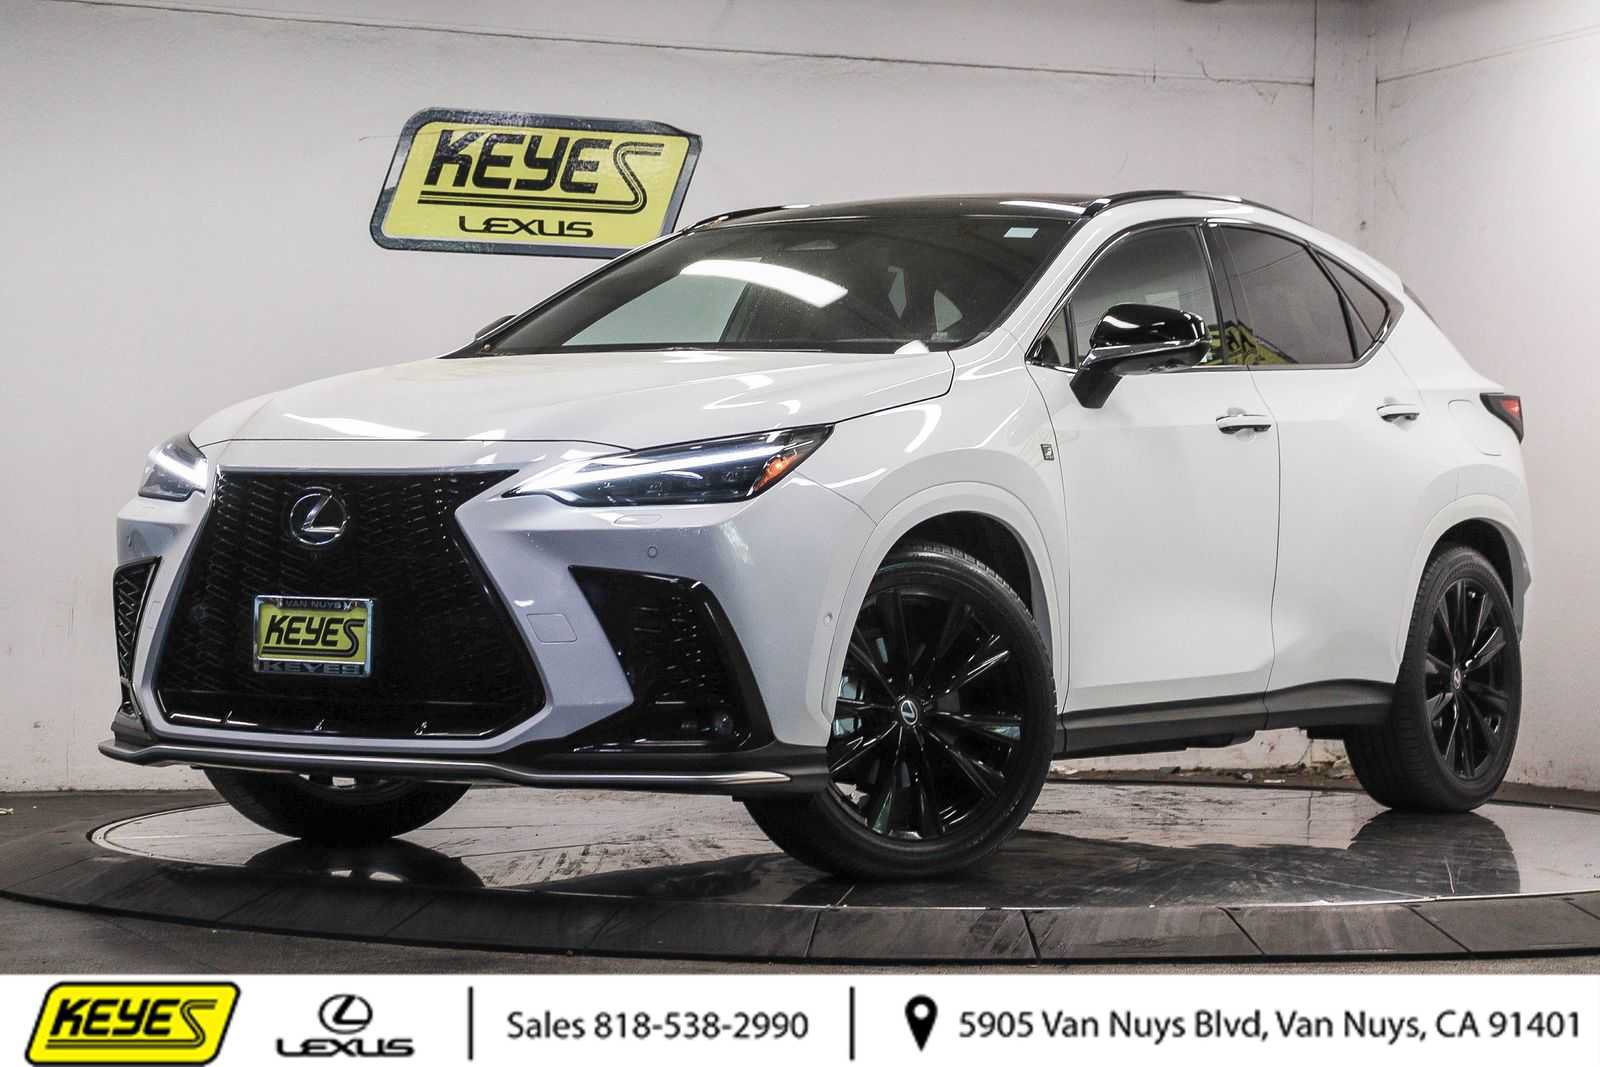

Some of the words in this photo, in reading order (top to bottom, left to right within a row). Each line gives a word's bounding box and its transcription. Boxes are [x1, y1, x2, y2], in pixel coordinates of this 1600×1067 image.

[418, 130, 664, 214] KEYES
[459, 215, 593, 238] LEXUS
[286, 600, 307, 608] VAN
[261, 615, 366, 657] KEYES
[263, 661, 361, 675] KEYES
